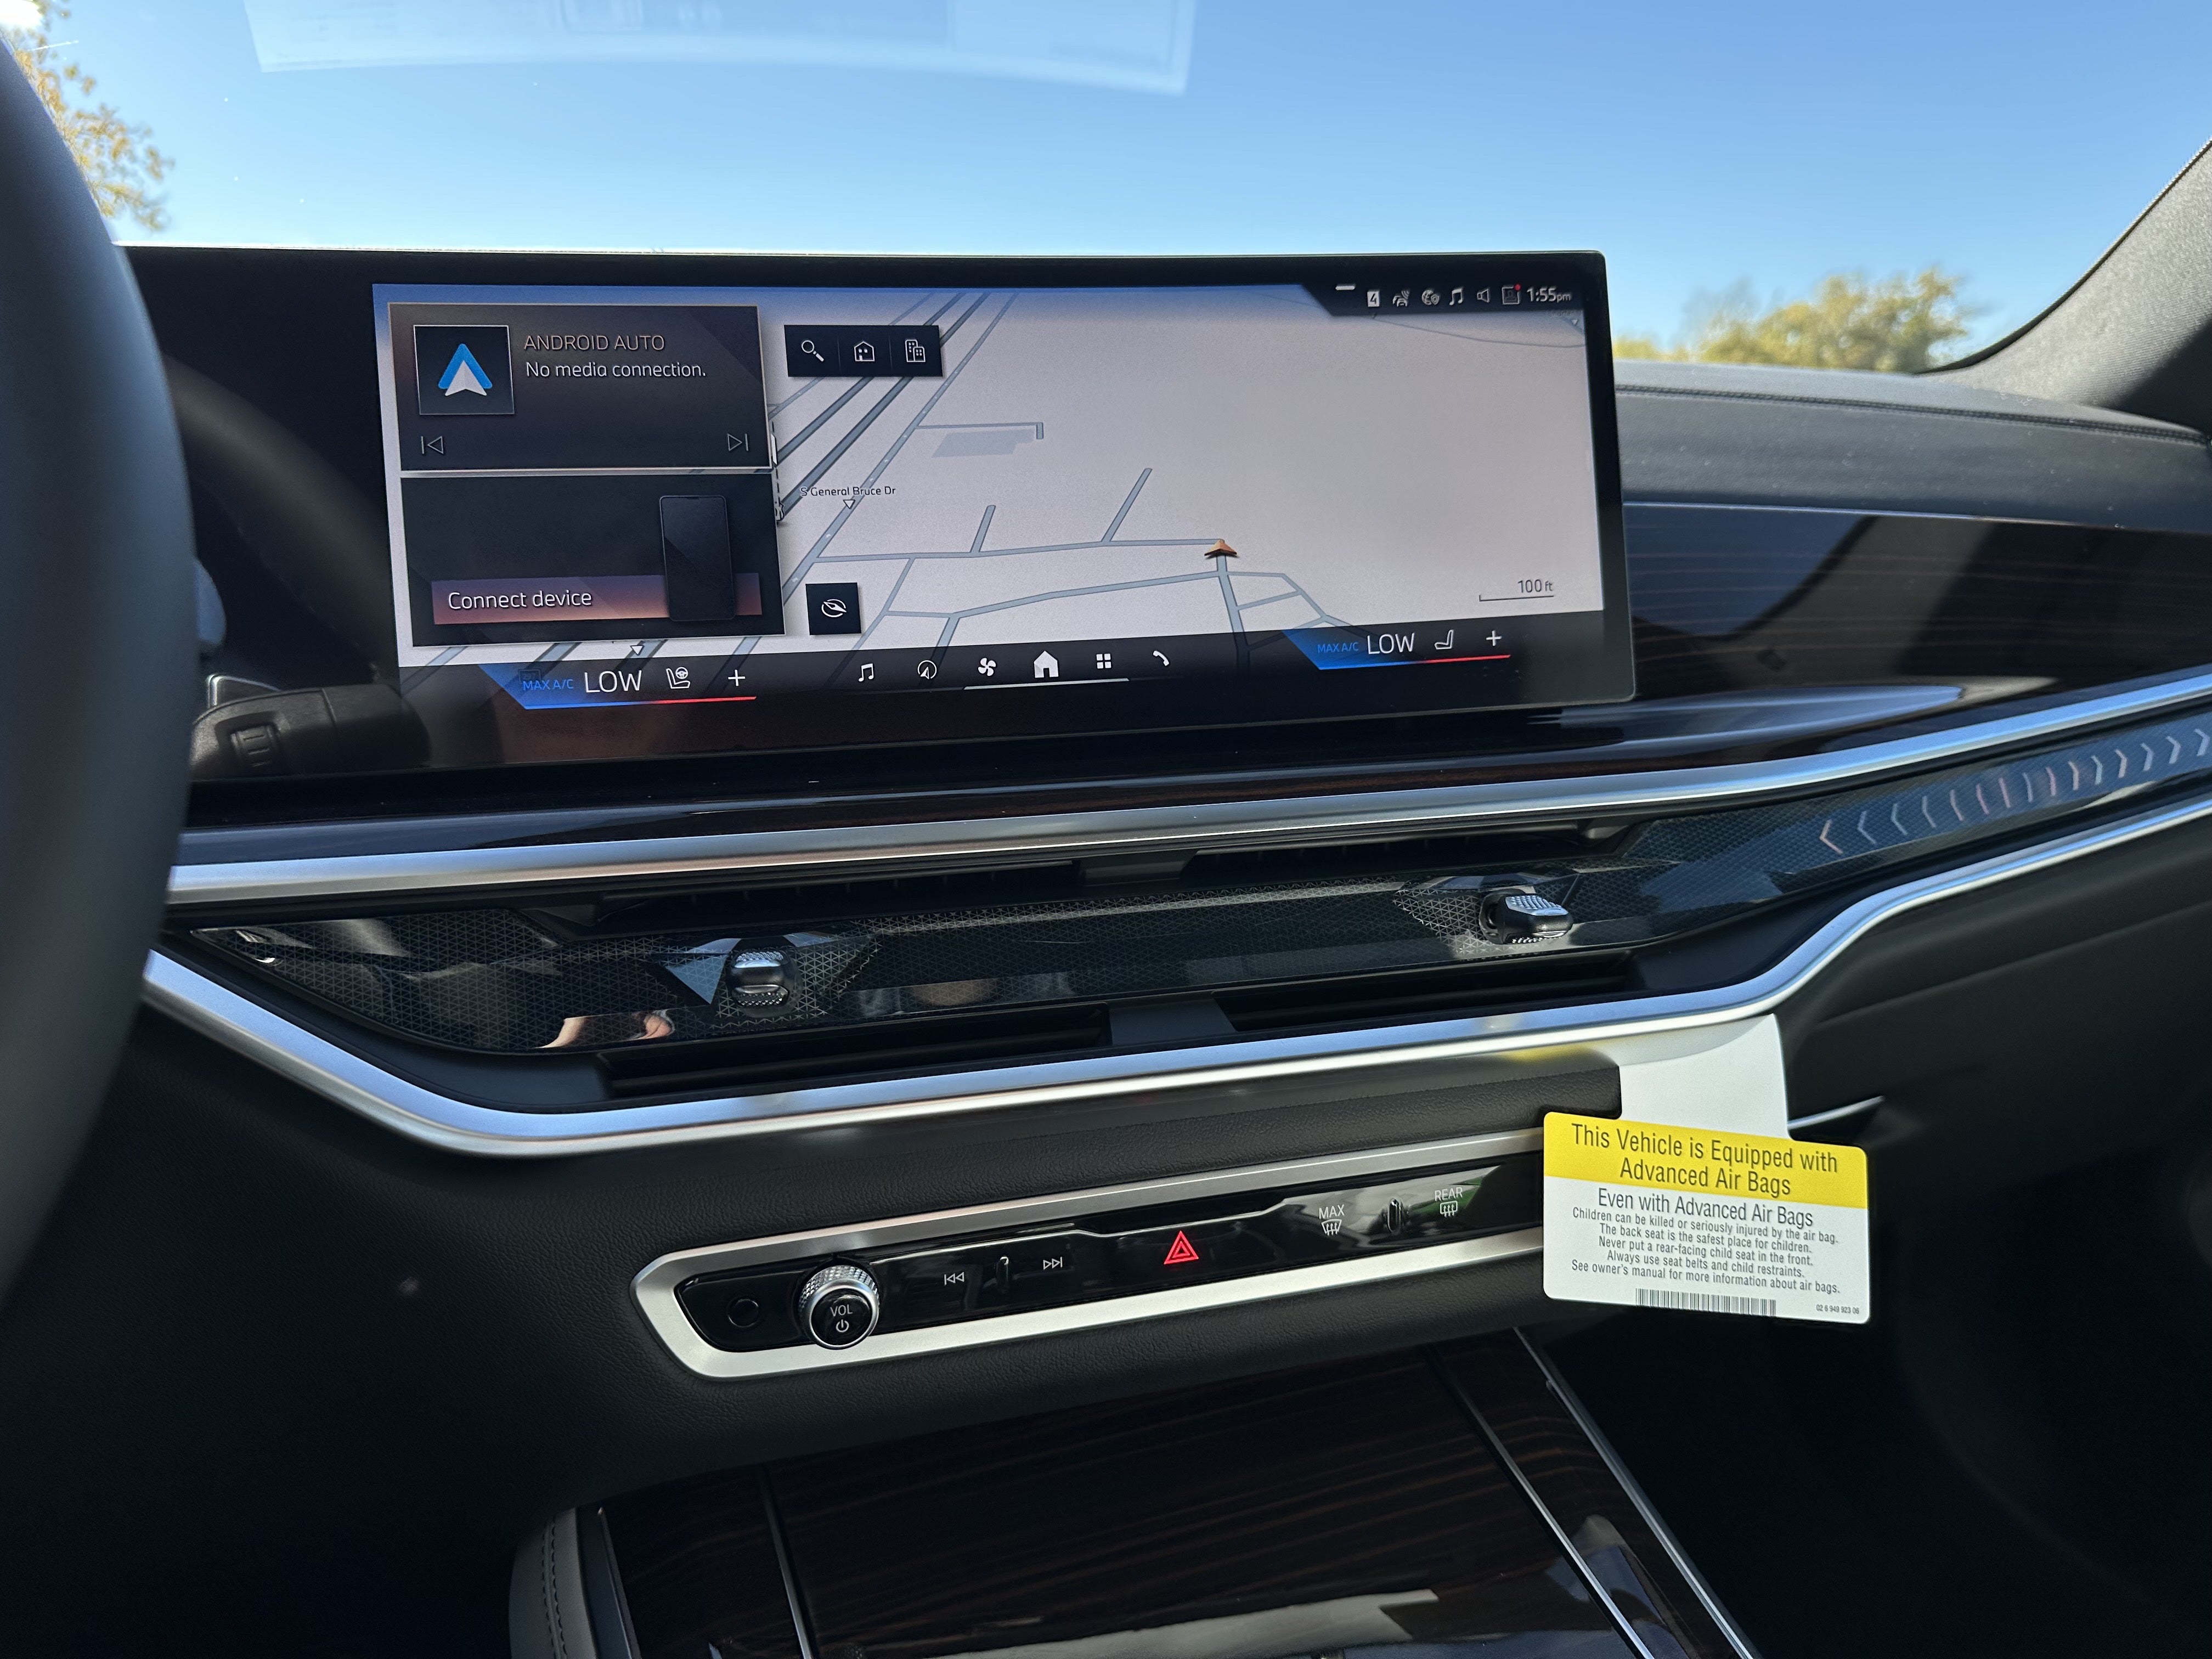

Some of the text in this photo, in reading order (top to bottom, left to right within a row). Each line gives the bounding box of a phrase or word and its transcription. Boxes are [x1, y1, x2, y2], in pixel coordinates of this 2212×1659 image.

[1527, 287, 1571, 303] 1:55pm
[524, 335, 665, 351] ANDROID AUTO
[526, 362, 707, 377] No media connection.
[800, 486, 896, 496] S General Bruce Dr
[448, 590, 592, 610] Connect device
[1317, 642, 1359, 653] MAX A/C
[1367, 632, 1415, 655] LOW
[523, 679, 574, 691] MAX A/C
[584, 670, 642, 693] LOW
[1571, 1123, 1837, 1172] This Vehicle is Equipped with
[1620, 1157, 1791, 1198] Advanced Air Bags
[1435, 1187, 1463, 1201] REAR
[1318, 1204, 1345, 1220] MAX
[1599, 1187, 1813, 1229] Even with Advanced Air Bags
[1573, 1207, 1838, 1244] Children can be killed or seriously injured by the air bag.
[1600, 1223, 1812, 1253] The back seat is the safest place for children.
[1599, 1235, 1813, 1266] Never put a rear-facing child seat in the front.
[1607, 1250, 1804, 1278] Always use seat belts and child restraints.
[1572, 1259, 1588, 1271] See
[1632, 1266, 1666, 1278] manual
[1669, 1268, 1683, 1279] for
[1686, 1272, 1709, 1282] more
[1713, 1272, 1767, 1287] information
[1770, 1277, 1797, 1289] about
[1800, 1279, 1812, 1290] air
[1815, 1280, 1840, 1295] bags.
[830, 1305, 853, 1317] VOL
